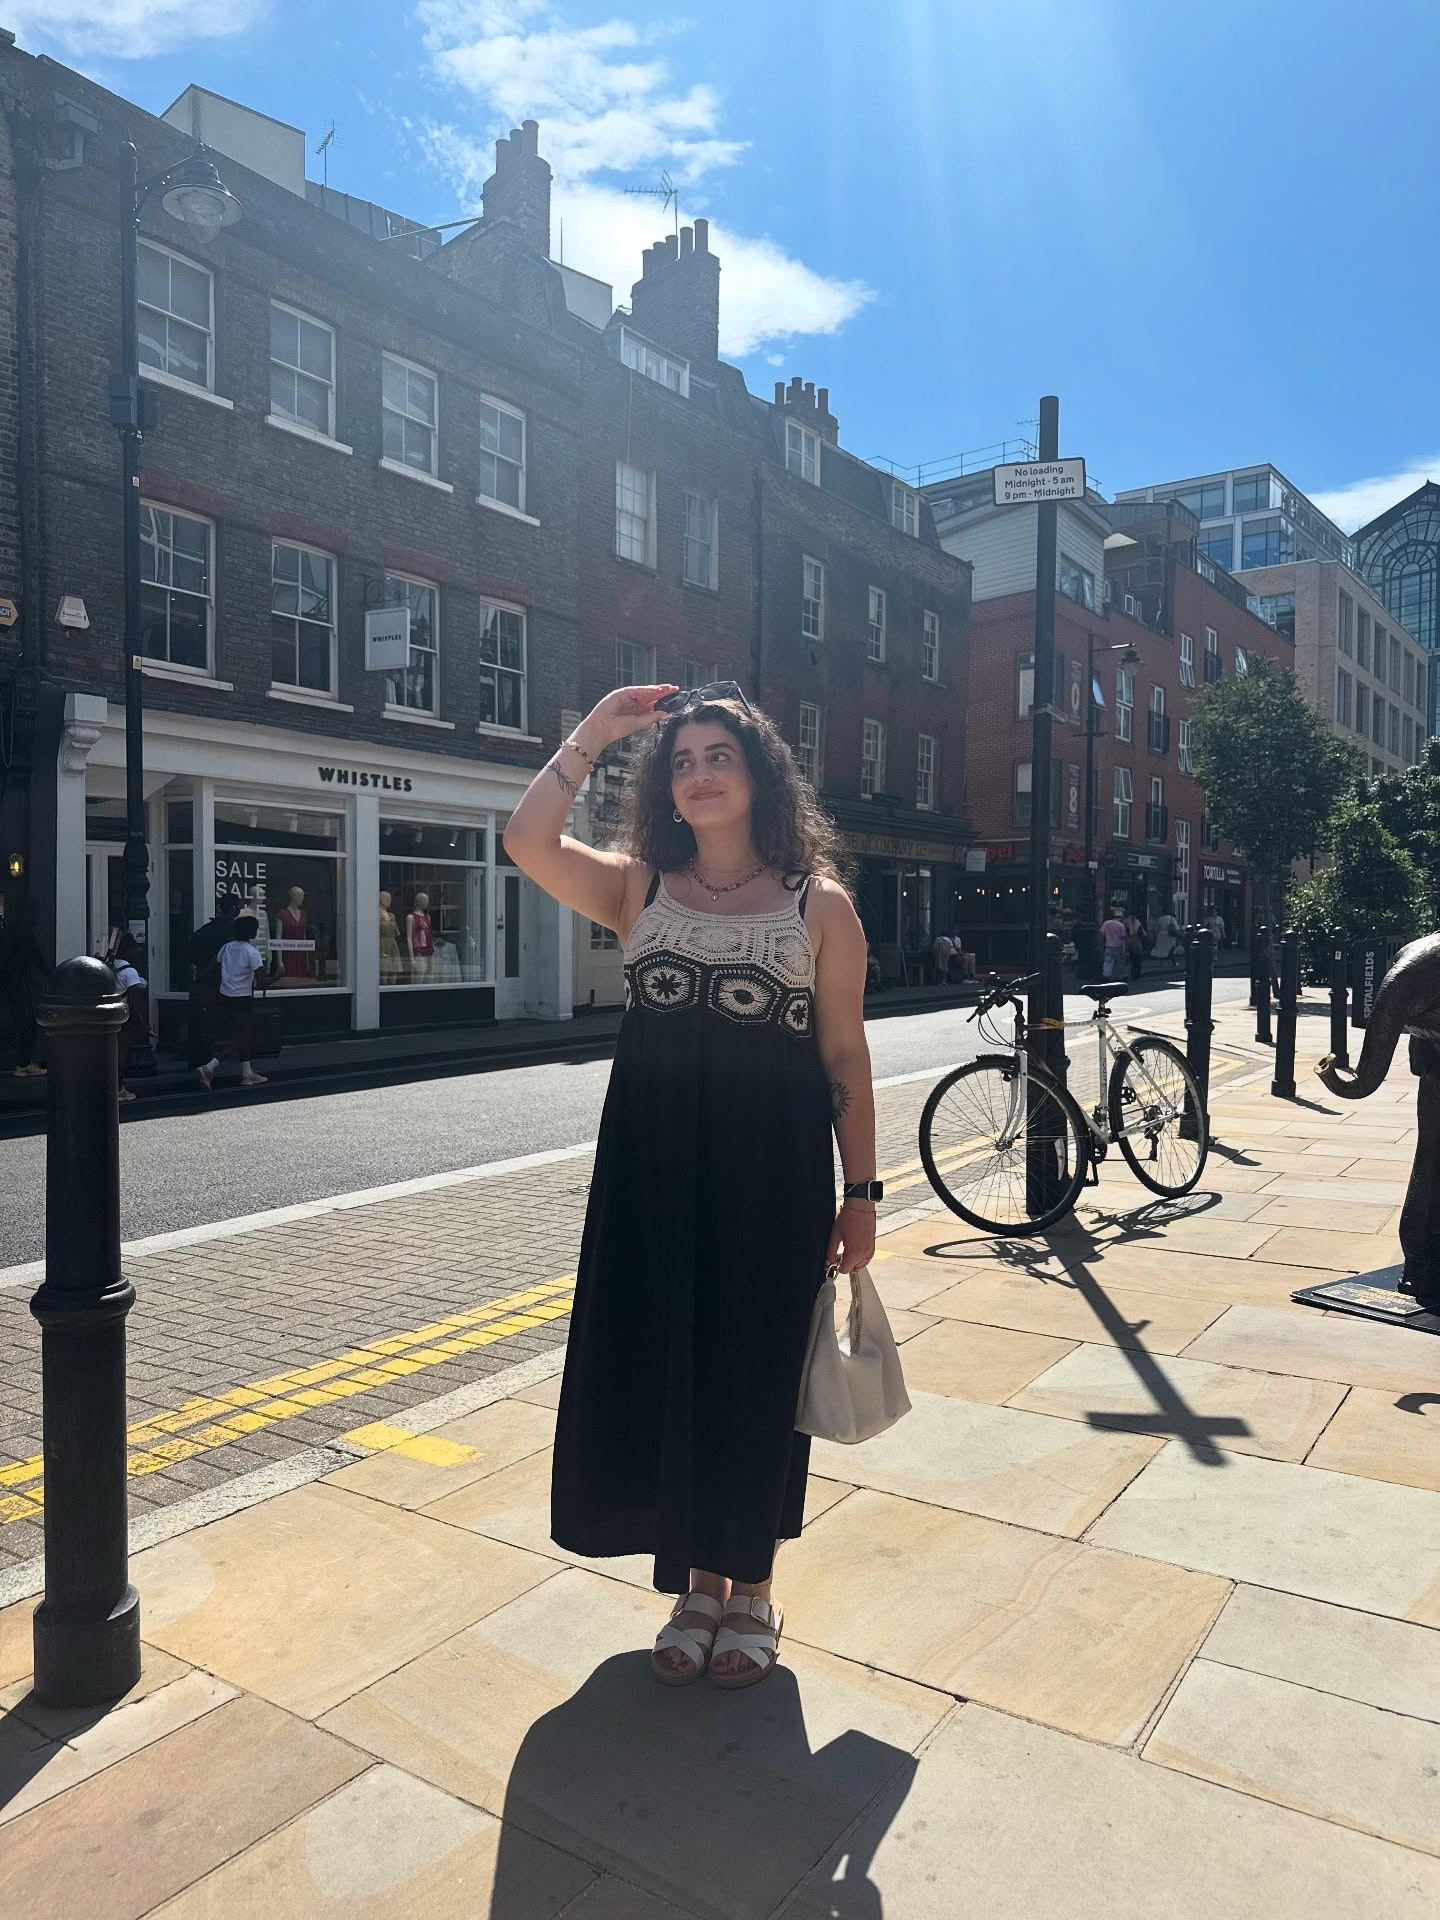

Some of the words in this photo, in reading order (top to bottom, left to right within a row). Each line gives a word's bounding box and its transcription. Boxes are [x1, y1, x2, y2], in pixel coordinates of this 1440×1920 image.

[1015, 468, 1028, 477] No
[1029, 466, 1063, 476] loading
[1005, 478, 1045, 488] Midnight
[1034, 486, 1075, 497] Midnight
[372, 634, 402, 642] WHISTLES
[318, 766, 412, 792] WHISTLES
[216, 860, 267, 879] SALE
[1203, 865, 1225, 881] TORTILLA
[216, 881, 267, 900] SALE
